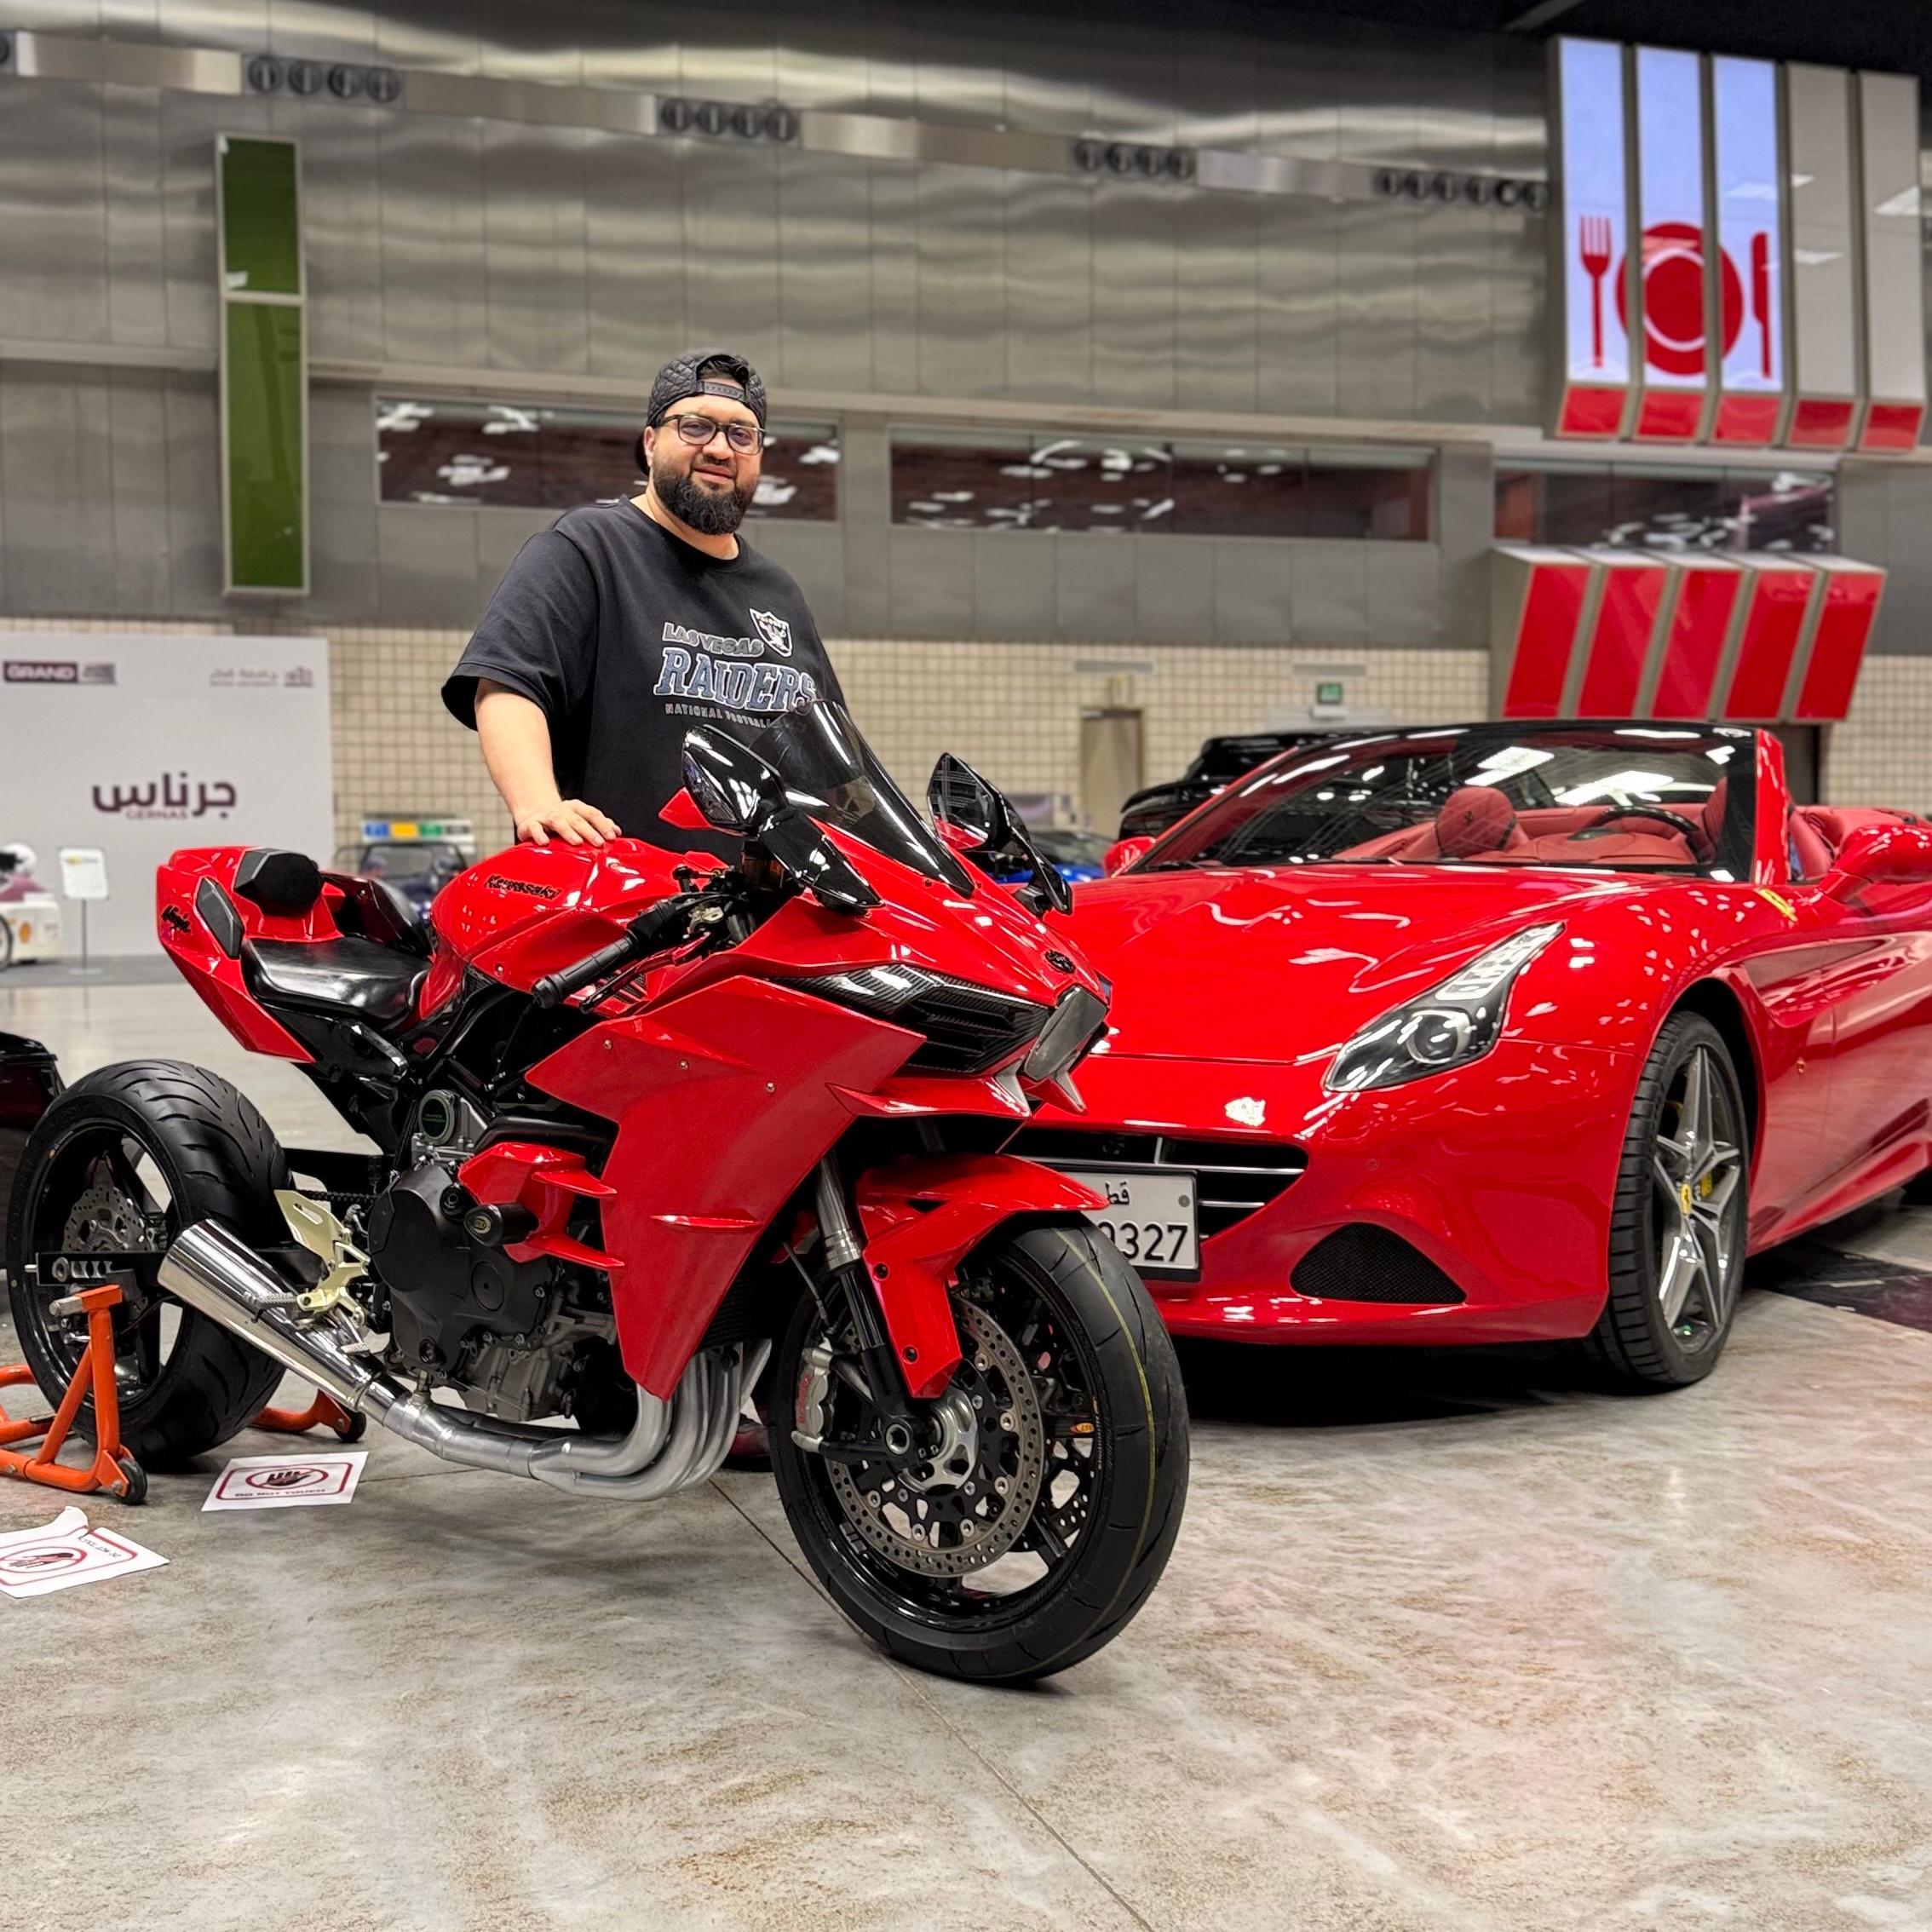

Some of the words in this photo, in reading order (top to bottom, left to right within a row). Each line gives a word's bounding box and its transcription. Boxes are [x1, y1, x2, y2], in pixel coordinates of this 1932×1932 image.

[662, 622, 699, 647] LAS
[699, 633, 765, 658] VEGAS
[7, 665, 76, 680] GRAND
[653, 647, 817, 711] RAIDERS
[665, 703, 723, 719] NATIONAL
[92, 771, 237, 819] جرناس
[483, 874, 563, 900] Kawasaki
[1105, 1181, 1130, 1205] قط
